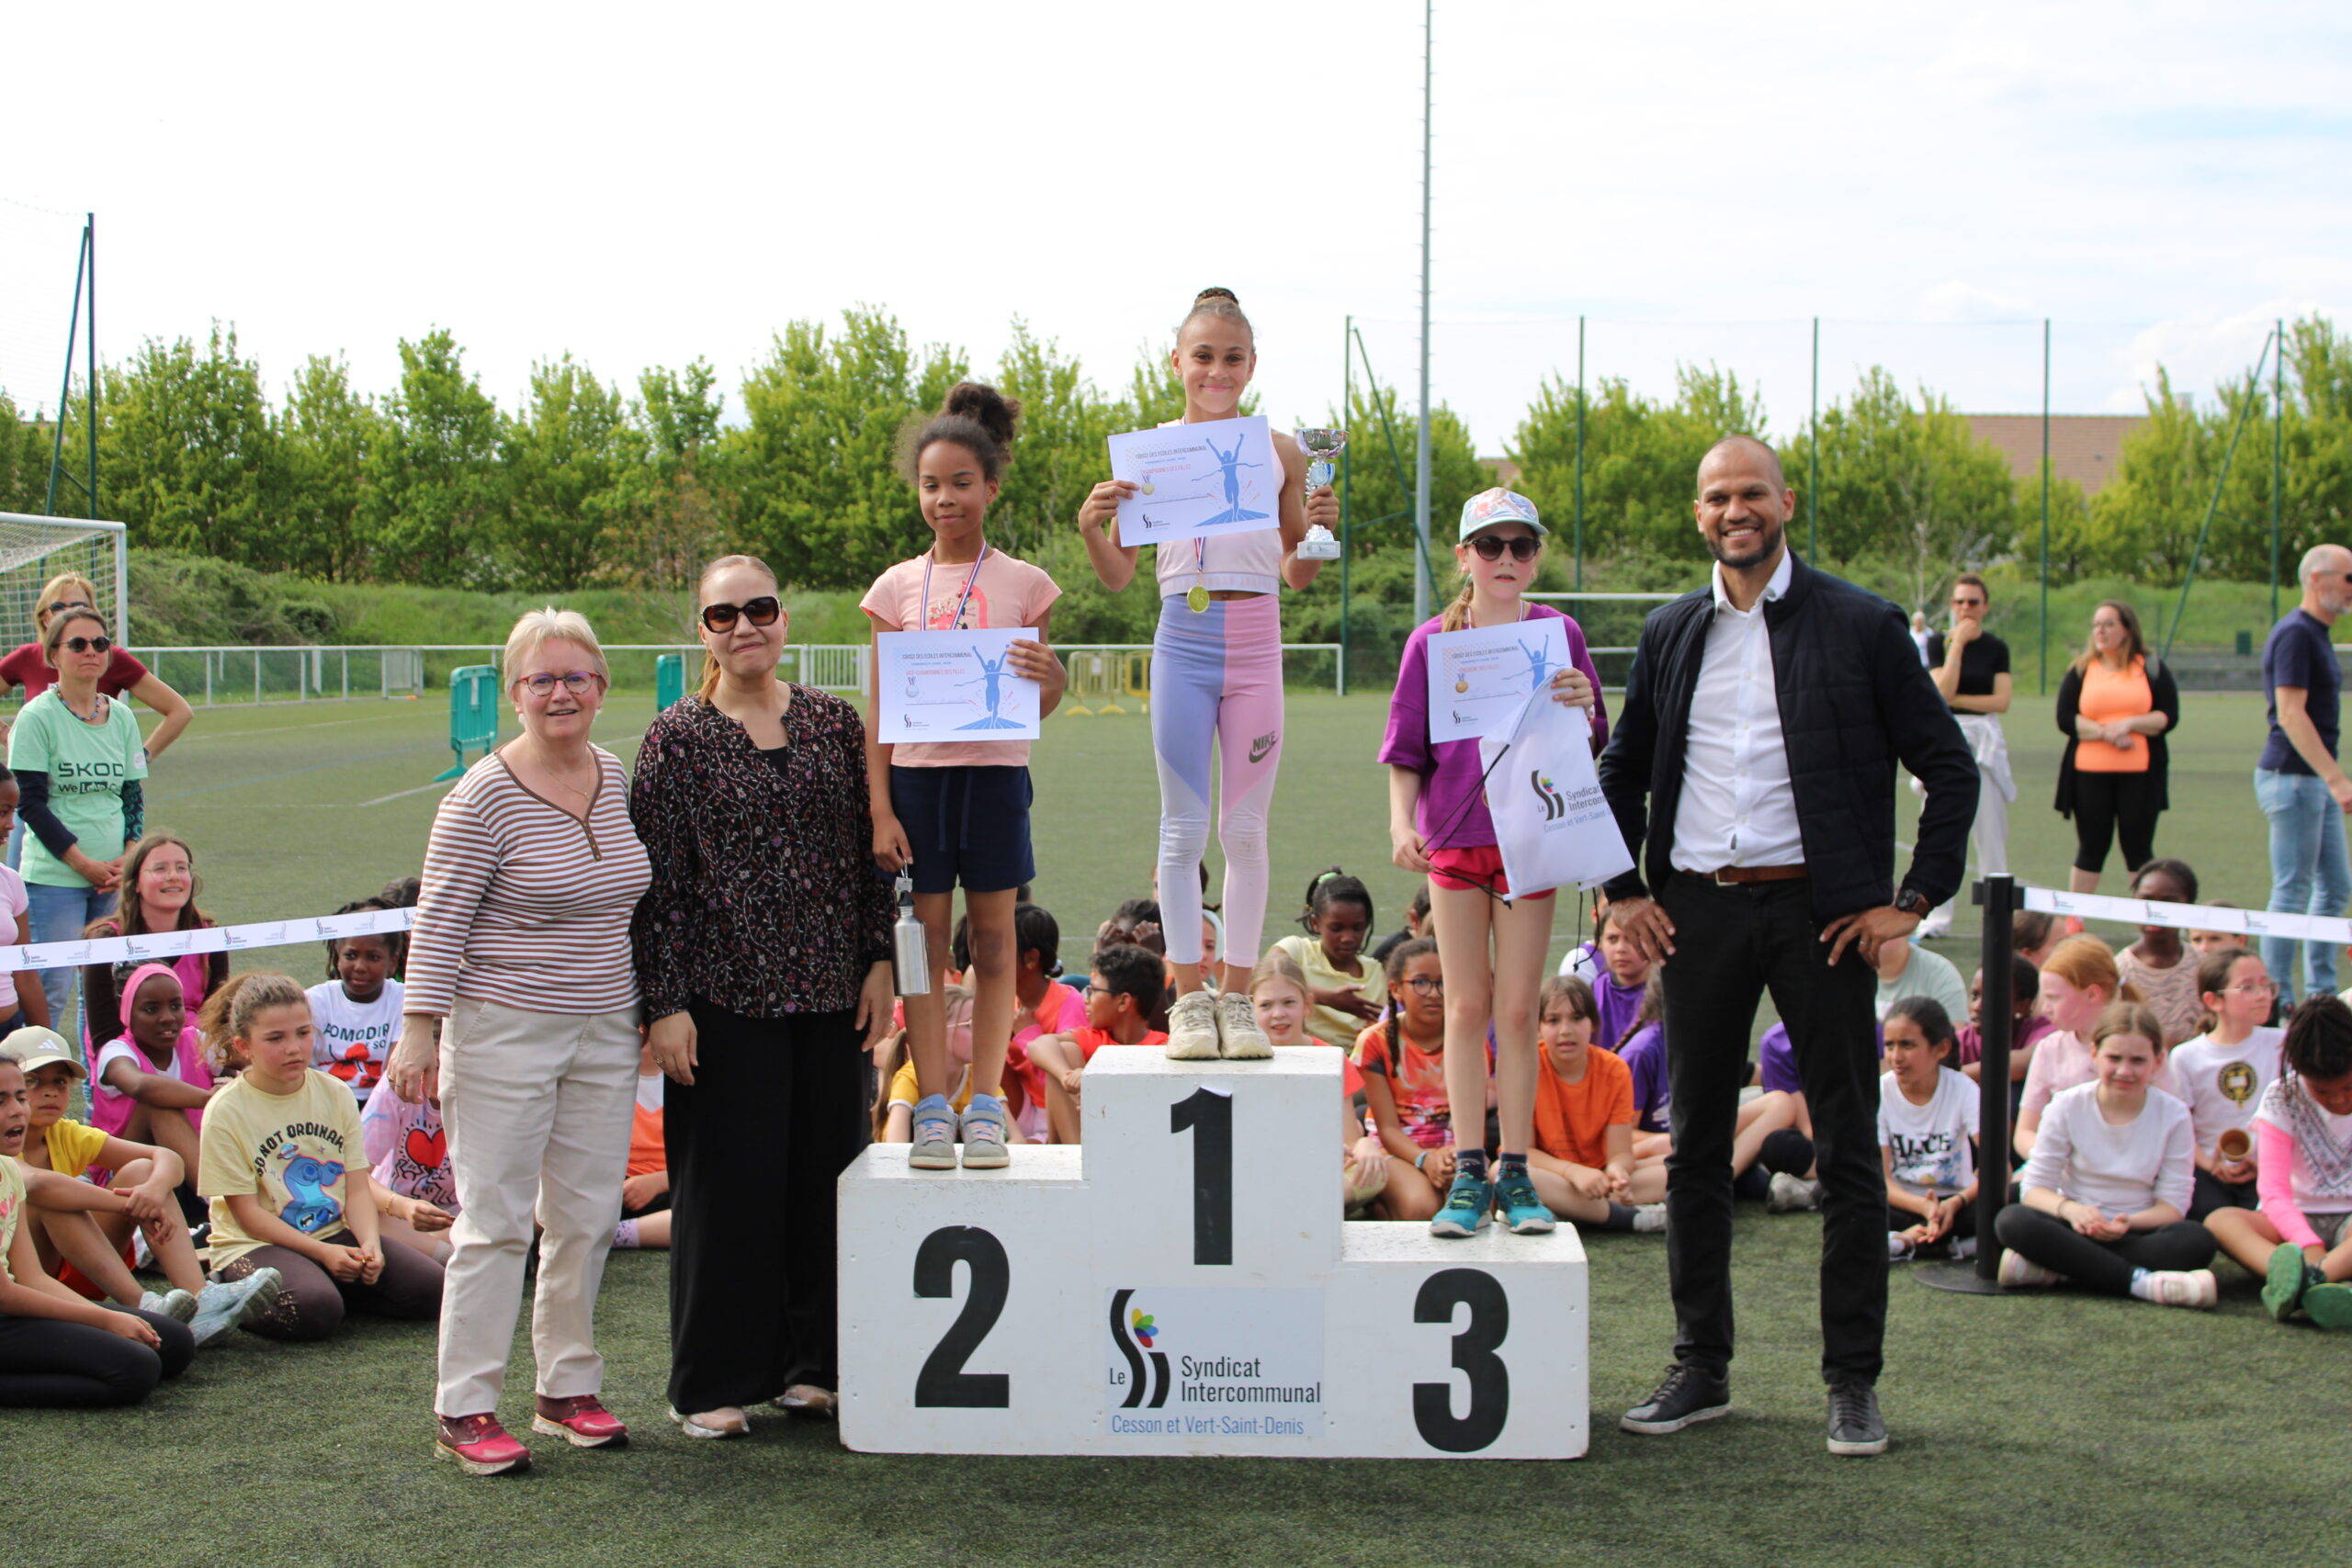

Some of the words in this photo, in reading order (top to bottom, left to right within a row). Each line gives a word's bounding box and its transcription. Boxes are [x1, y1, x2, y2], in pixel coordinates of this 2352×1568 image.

[1253, 730, 1275, 752] NIKE
[58, 784, 78, 794] We
[1566, 784, 1600, 801] Syndicat
[259, 1130, 284, 1158] NOT
[286, 1122, 345, 1154] ORDINAR
[1170, 1087, 1232, 1265] 1
[913, 1225, 1010, 1408] 2
[1182, 1355, 1261, 1381] Syndicat
[1412, 1268, 1509, 1452] 3
[1110, 1368, 1125, 1385] Le
[1182, 1381, 1321, 1403] Intercommunal
[1112, 1415, 1161, 1434] Cesson
[1167, 1416, 1181, 1433] et
[1185, 1416, 1305, 1435] Vert-Saint-Denis
